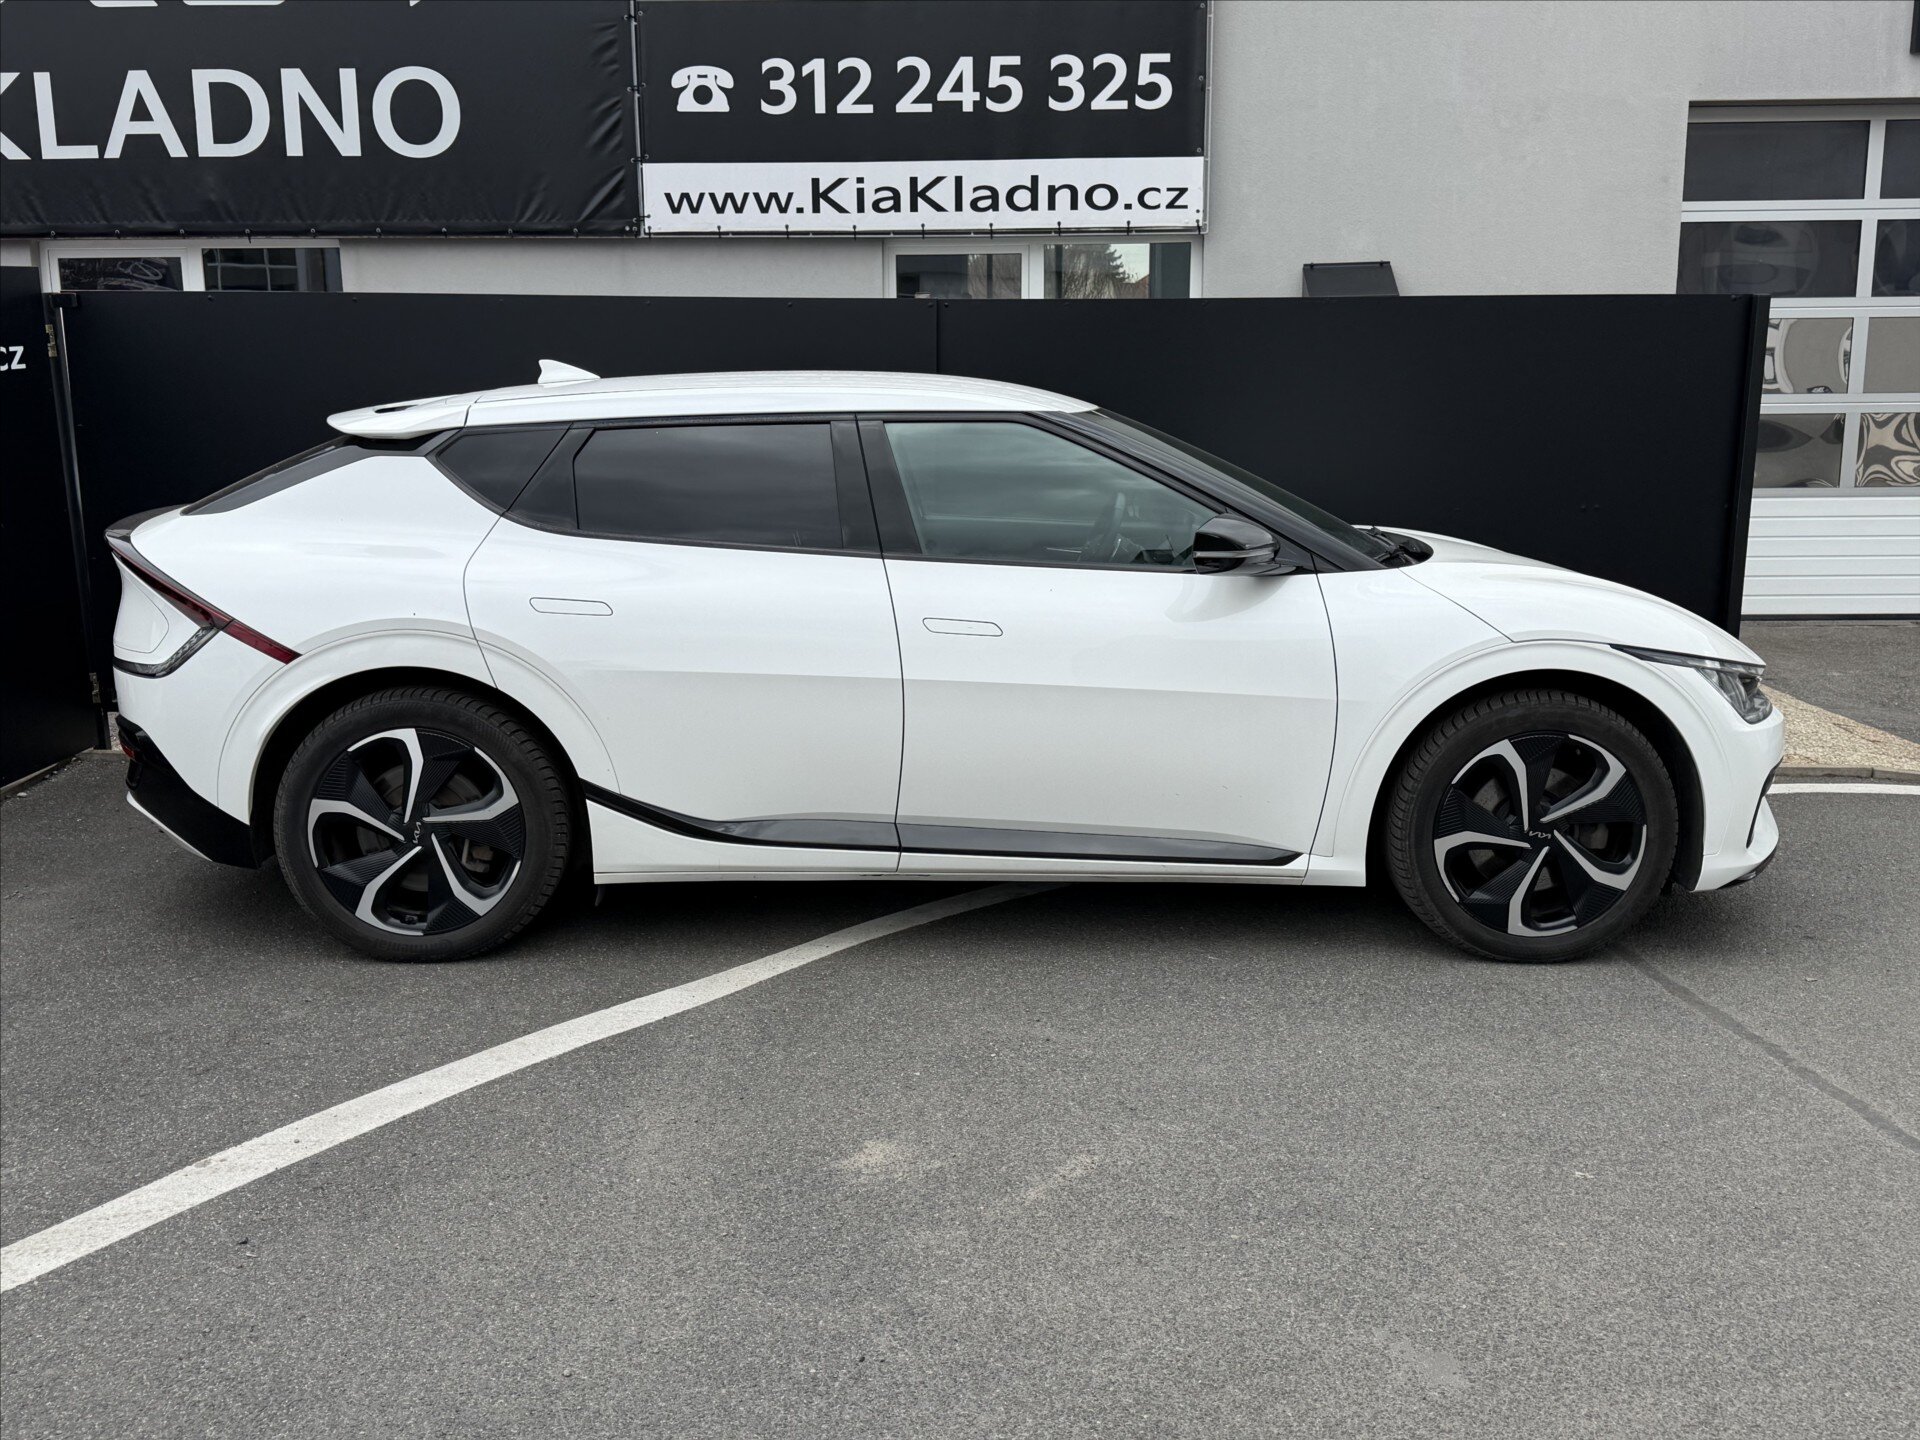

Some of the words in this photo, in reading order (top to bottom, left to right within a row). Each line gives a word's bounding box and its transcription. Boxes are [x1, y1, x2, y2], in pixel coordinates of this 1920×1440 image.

[761, 57, 874, 115] 312
[895, 56, 1024, 113] 245
[1048, 53, 1173, 112] 325
[664, 175, 1189, 214] www.KiaKladno.cz
